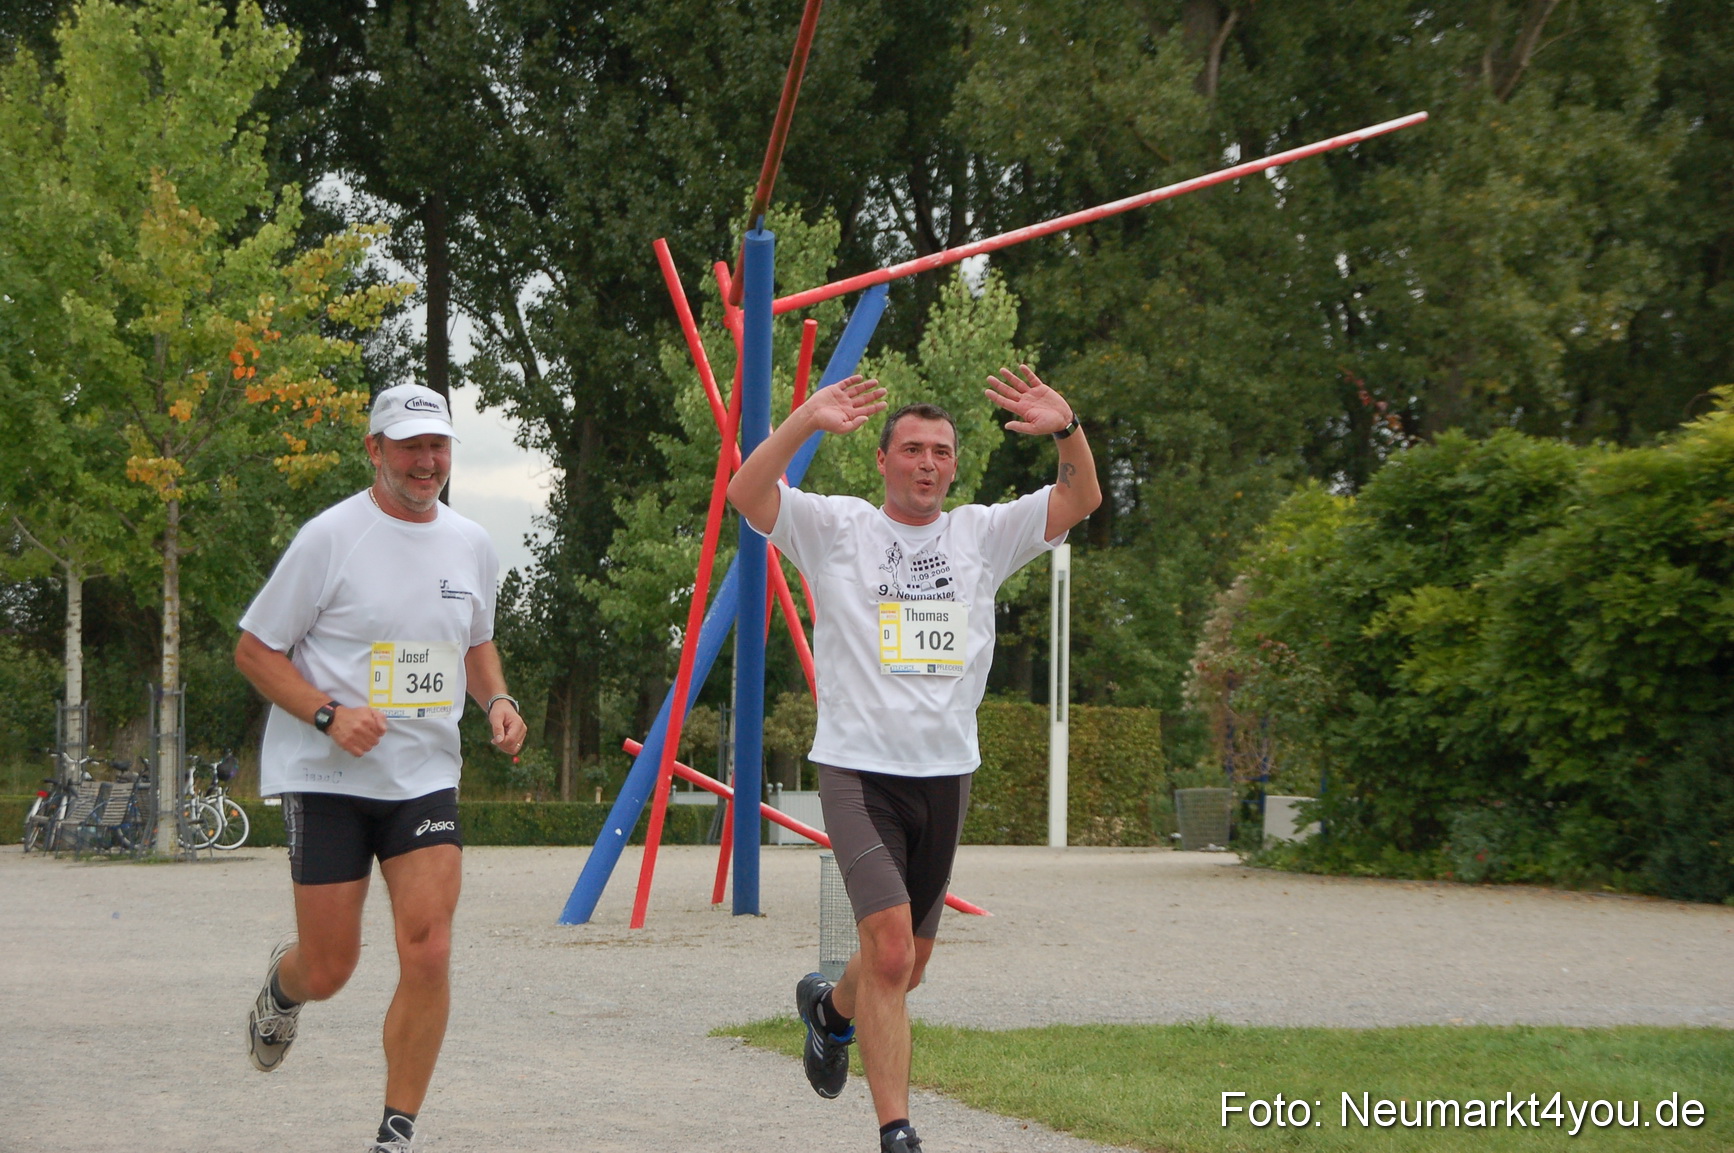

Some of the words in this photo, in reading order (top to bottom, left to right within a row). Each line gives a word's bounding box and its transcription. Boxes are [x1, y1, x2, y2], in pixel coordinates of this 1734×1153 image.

[878, 584, 893, 597] 9.
[896, 590, 955, 601] Neumarkter
[905, 607, 949, 622] Thomas
[915, 630, 955, 651] 102
[398, 648, 430, 663] Josef
[406, 672, 444, 694] 346
